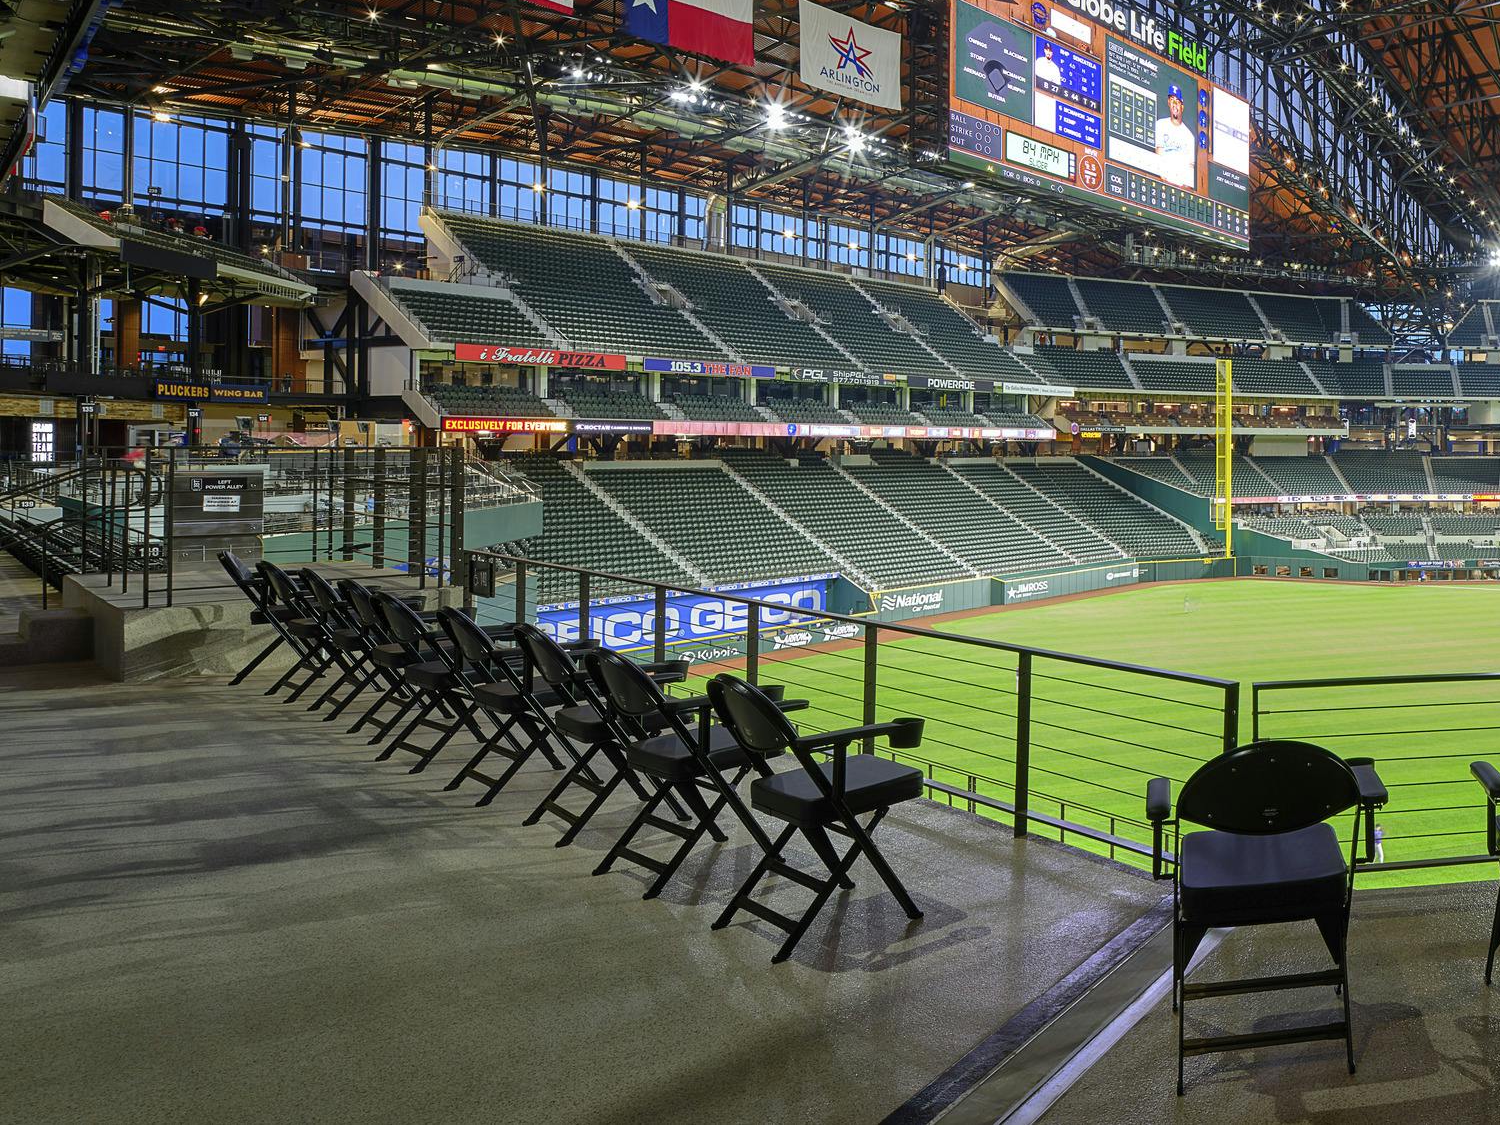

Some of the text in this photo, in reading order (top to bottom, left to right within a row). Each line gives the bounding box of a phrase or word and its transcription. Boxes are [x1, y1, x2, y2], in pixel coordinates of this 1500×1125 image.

[968, 37, 988, 49] OWINGS
[989, 33, 1003, 44] DAHL
[1131, 9, 1165, 51] Life
[1168, 30, 1207, 72] Field
[970, 52, 986, 63] STORY
[820, 66, 880, 93] ARLINGTON
[1051, 84, 1059, 93] 27
[1083, 97, 1088, 105] T
[951, 113, 967, 124] BALL
[950, 124, 973, 137] STRIKE
[951, 135, 965, 145] OUT
[1023, 140, 1036, 156] 84
[1003, 170, 1014, 179] TOR
[1111, 175, 1122, 185] COL
[1110, 184, 1122, 194] TEX
[491, 347, 555, 365] Fratelli
[558, 353, 607, 368] PIZZA
[670, 361, 753, 376] 105.3 THE FAN
[803, 369, 828, 380] PGL
[833, 370, 880, 380] ShipPGL.com
[927, 378, 975, 390] POWERADE
[157, 383, 263, 399] PLUCKERS WING BAR
[82, 405, 94, 413] 135
[445, 420, 567, 432] EXCLUSIVELY FOR EVERYONE
[32, 442, 53, 452] TEAM
[781, 577, 799, 585] GEICO
[609, 596, 631, 604] GEICO
[895, 589, 943, 608] National
[690, 588, 821, 634] GECO
[922, 603, 941, 611] Rental
[697, 647, 739, 661] Kubota
